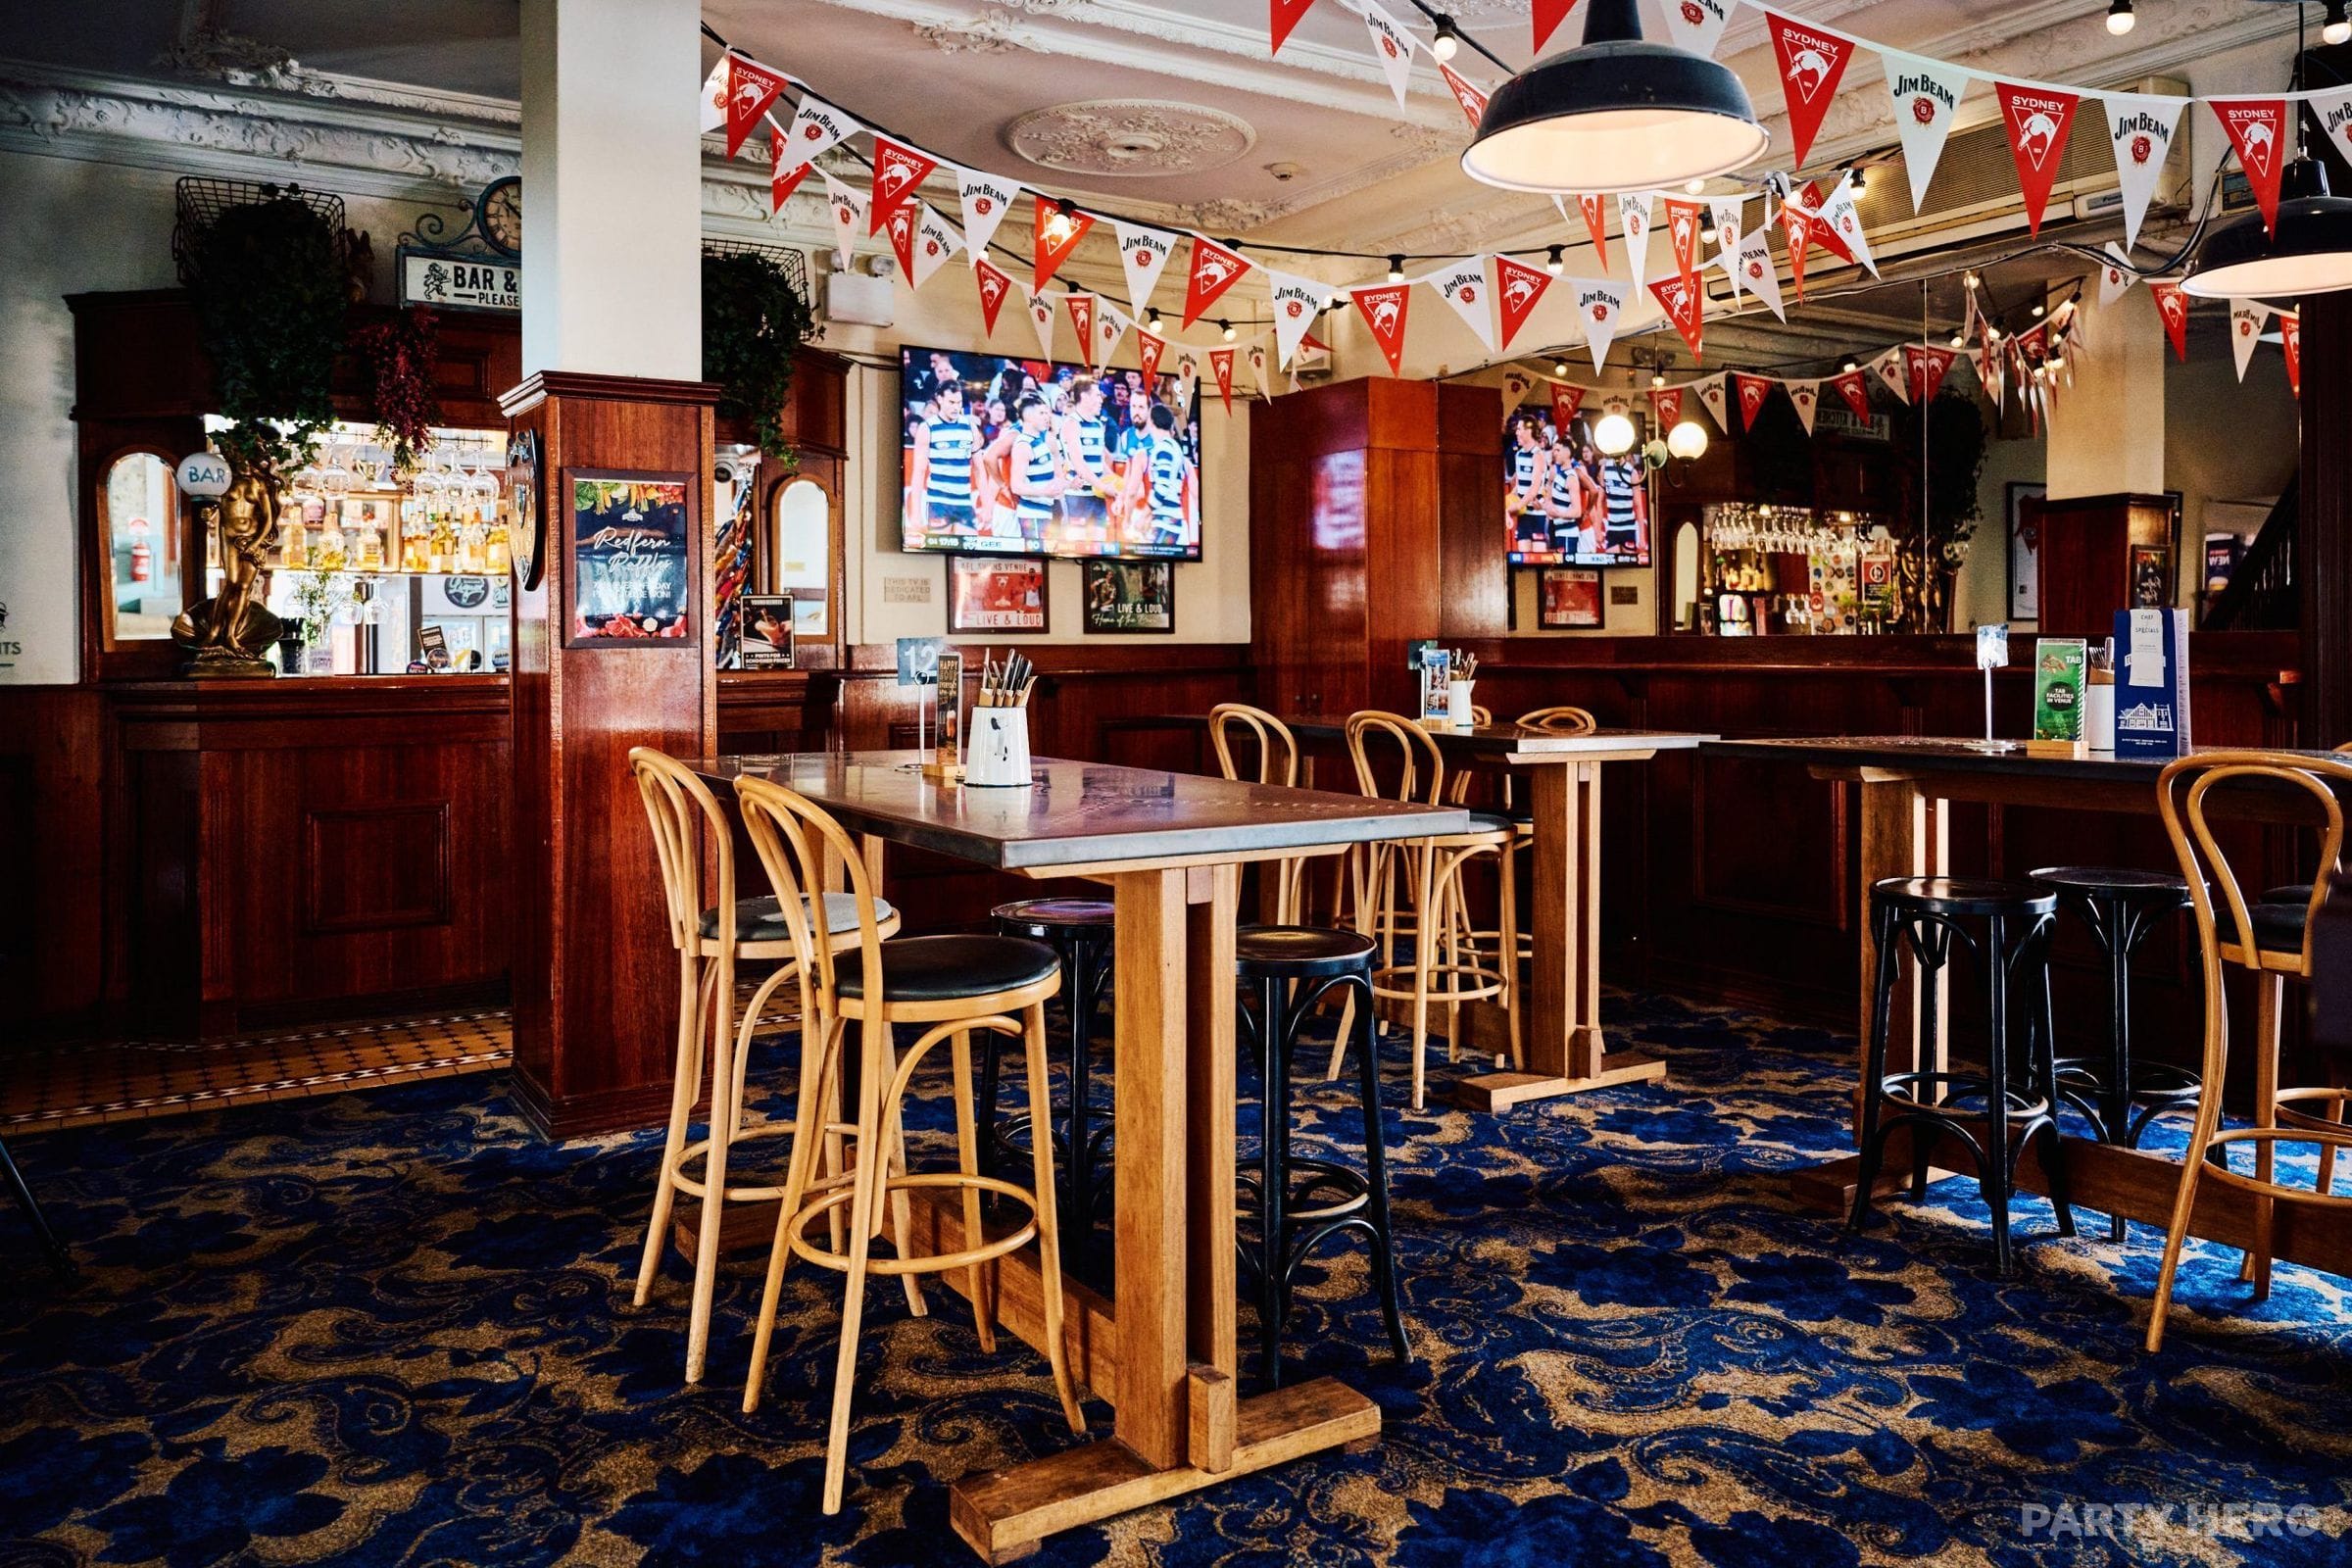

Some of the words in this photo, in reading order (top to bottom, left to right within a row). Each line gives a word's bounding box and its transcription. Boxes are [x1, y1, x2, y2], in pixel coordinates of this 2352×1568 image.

[1368, 13, 1384, 30] JIM
[1383, 20, 1409, 58] BEAM
[1784, 27, 1838, 54] SYDNEY
[736, 67, 775, 87] SYDNEY
[1893, 74, 1919, 97] JIM
[1921, 74, 1953, 111] BEAM
[2012, 95, 2064, 112] SYDNEY
[2228, 109, 2275, 118] SYDNEY
[799, 108, 820, 122] JIM
[818, 114, 841, 141] BEAM
[2115, 117, 2137, 140] JIM
[2138, 112, 2169, 144] BEAM
[2328, 108, 2344, 133] JIM
[885, 149, 924, 169] SYDNEY
[962, 183, 981, 197] JIM
[983, 183, 1007, 206] BEAM
[831, 192, 843, 206] JIM
[843, 195, 860, 219] BEAM
[1045, 206, 1083, 225] SYEY
[1622, 197, 1633, 215] JIM
[1631, 200, 1648, 222] BEAM
[1670, 206, 1693, 216] SYDNEY
[921, 224, 936, 237] JIM
[935, 231, 952, 257] BEAM
[1123, 236, 1142, 251] JIM
[1142, 235, 1167, 256] BEAM
[1201, 247, 1240, 270] SYDNEY
[454, 266, 494, 291] BAR
[504, 270, 517, 293] &
[1505, 266, 1543, 283] SYDNEY
[1660, 277, 1694, 293] SYDNY
[1445, 280, 1458, 298] JIM
[1456, 273, 1483, 285] BEAM
[478, 292, 519, 307] PLEASE
[1275, 287, 1294, 301] JIM
[1294, 287, 1318, 310] BEAM
[1364, 291, 1401, 303] SYDNEY
[1580, 293, 1596, 307] JIM
[1597, 290, 1620, 310] BEAM
[1099, 311, 1108, 322] JIM
[1107, 316, 1122, 336] BEAM
[188, 466, 225, 483] BAR
[593, 526, 671, 558] Redfern
[1117, 603, 1134, 613] LIVE
[1136, 603, 1143, 613] &
[1145, 604, 1163, 614] LOUD
[977, 614, 998, 626] LIVE
[1004, 614, 1011, 625] &
[1017, 615, 1042, 626] LOUD
[0, 642, 22, 656] TS
[904, 645, 938, 678] 12
[939, 660, 958, 670] HAPPY
[2065, 656, 2082, 664] TAB
